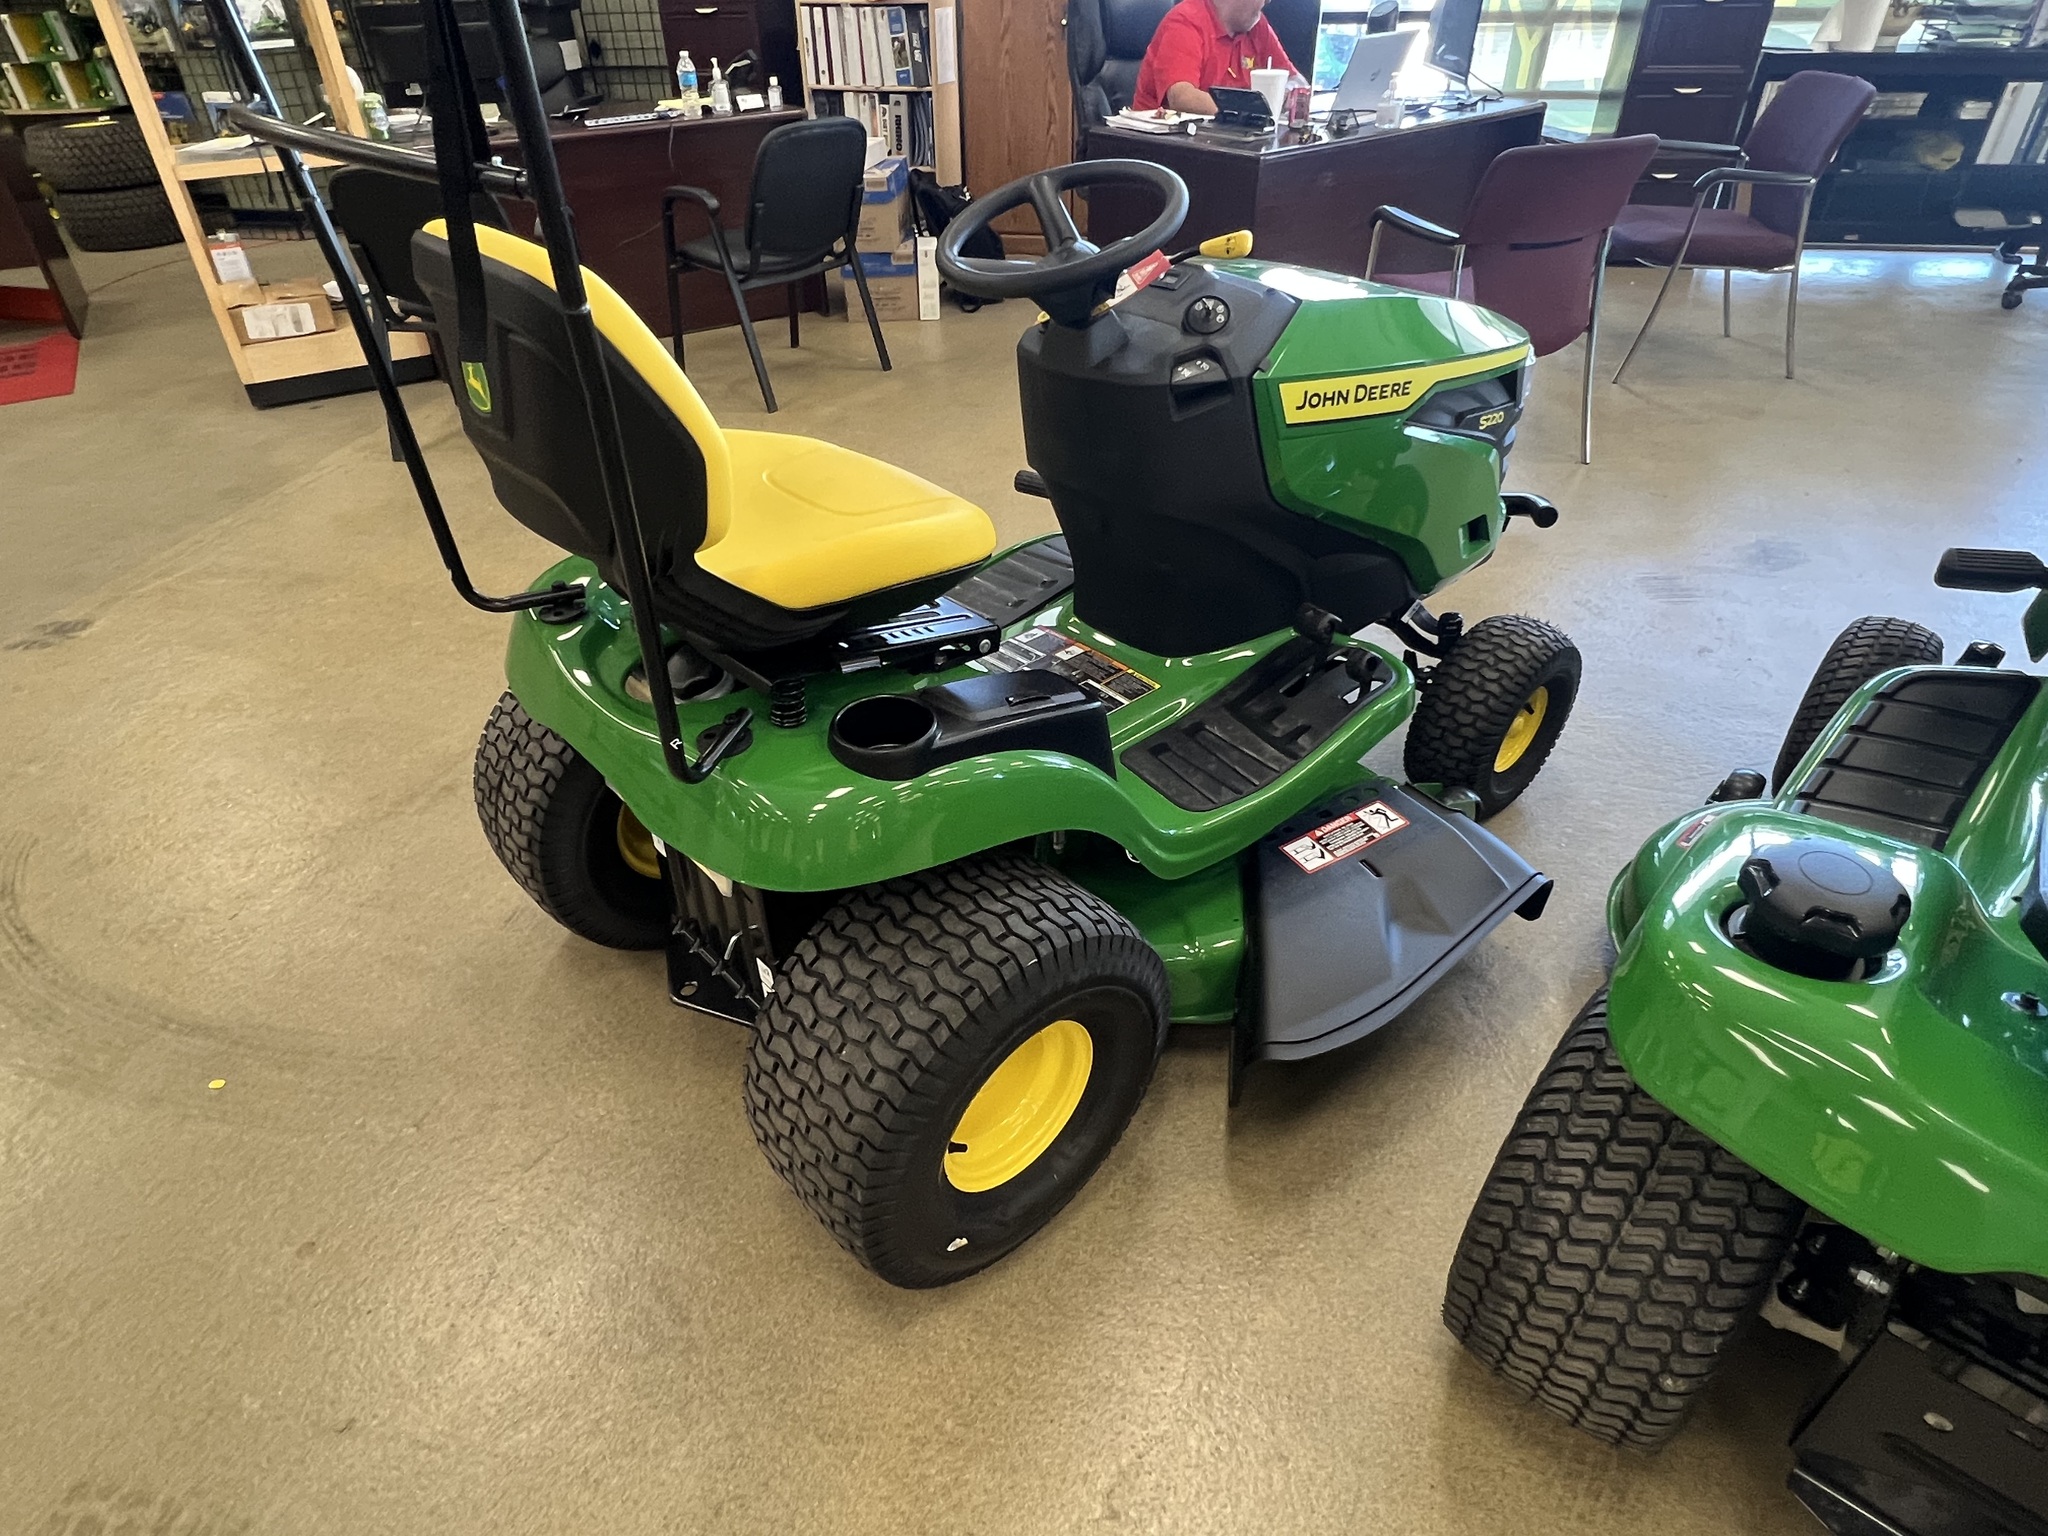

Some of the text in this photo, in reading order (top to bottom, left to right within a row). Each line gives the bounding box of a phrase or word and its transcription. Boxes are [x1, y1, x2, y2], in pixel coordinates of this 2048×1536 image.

[1296, 380, 1412, 411] JOHN DEERE
[1479, 411, 1504, 430] S220
[670, 738, 682, 750] R
